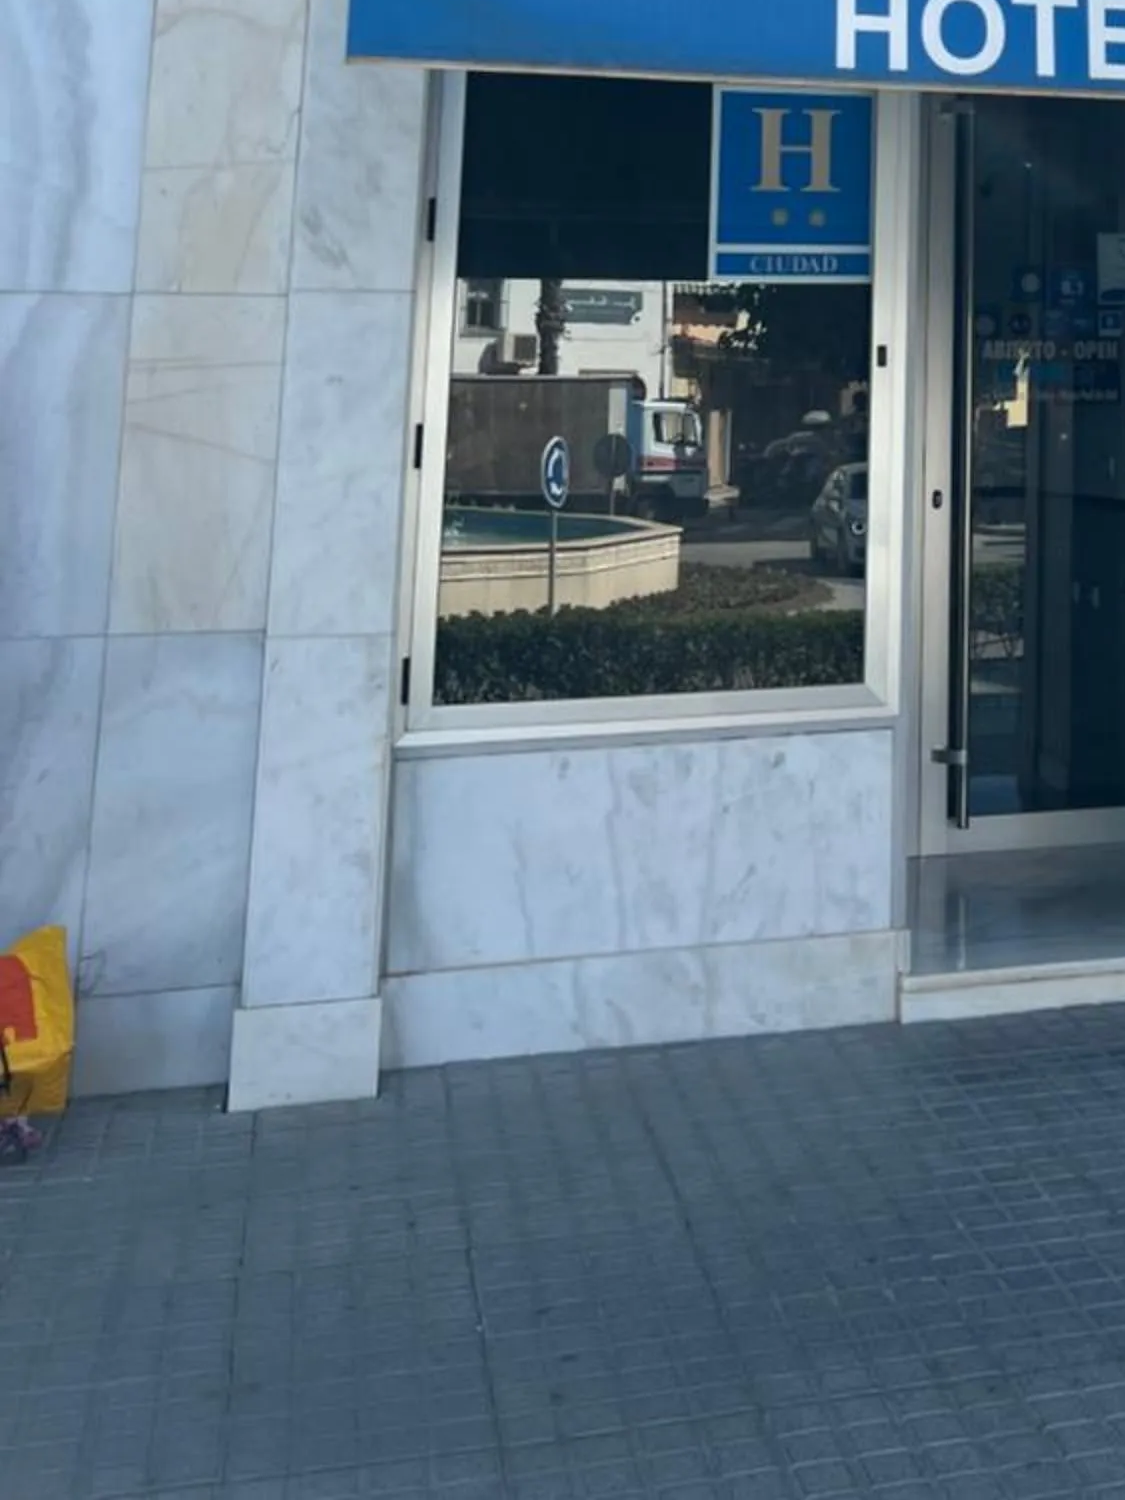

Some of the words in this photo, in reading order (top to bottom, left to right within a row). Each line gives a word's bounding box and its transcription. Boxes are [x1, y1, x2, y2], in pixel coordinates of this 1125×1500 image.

[750, 107, 842, 192] H
[750, 255, 838, 274] CIUDAD
[1073, 339, 1119, 360] OPEN
